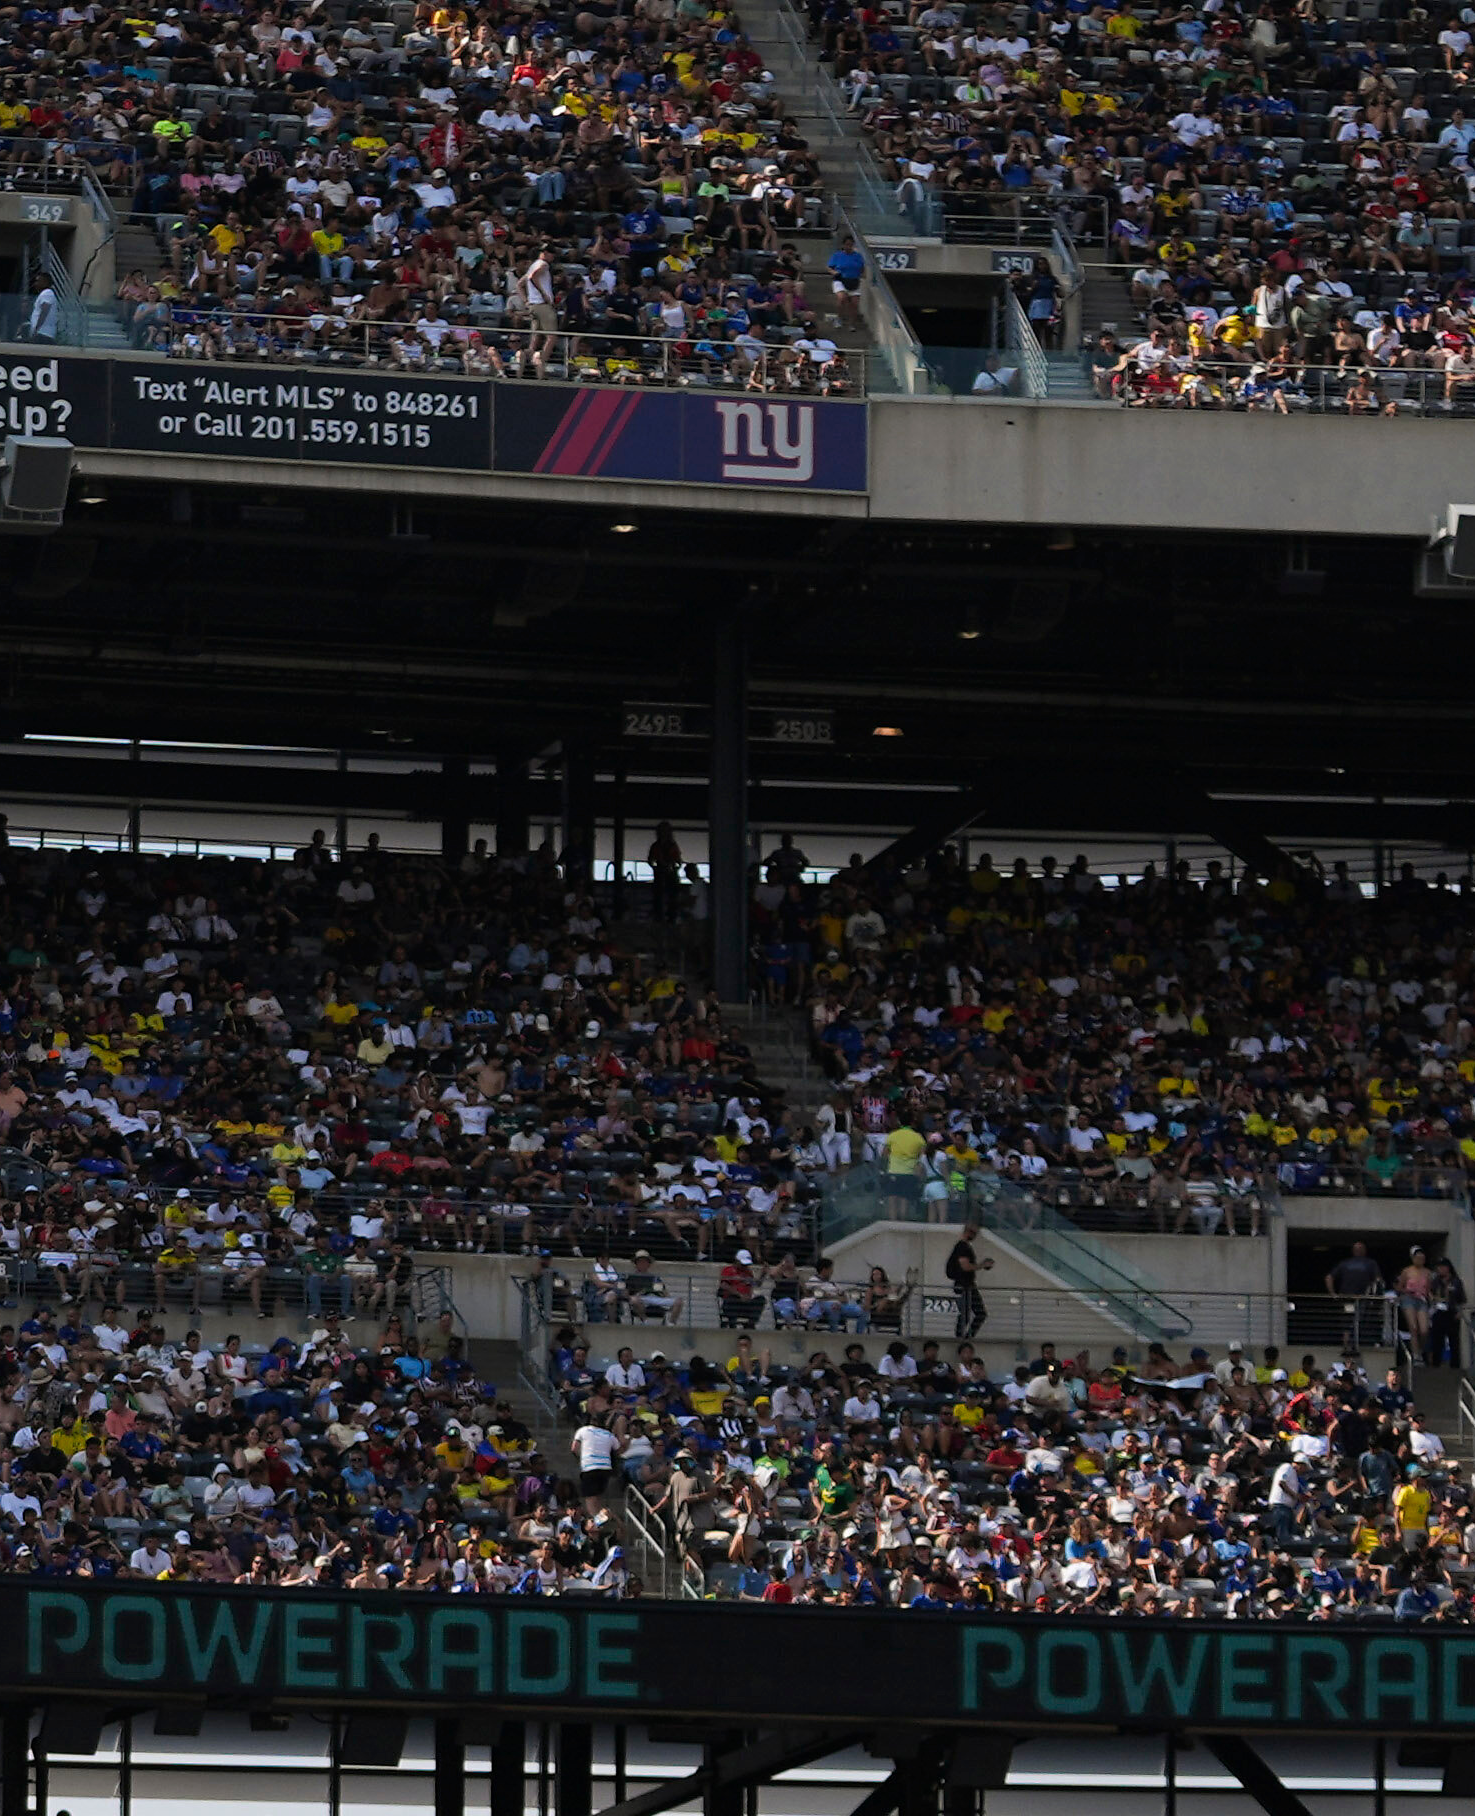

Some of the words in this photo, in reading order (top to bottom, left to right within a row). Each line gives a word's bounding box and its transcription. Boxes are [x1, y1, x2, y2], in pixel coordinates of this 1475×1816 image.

[27, 204, 62, 221] 349
[134, 376, 187, 402] Text
[352, 391, 378, 413] to
[384, 391, 479, 420] 848261
[159, 415, 188, 434] or
[194, 412, 243, 437] Call
[250, 414, 432, 449] 201.559.1515
[626, 713, 683, 734] 249B
[773, 719, 832, 741] 250B
[924, 1299, 959, 1312] 249A
[26, 1590, 642, 1699] POWERADE
